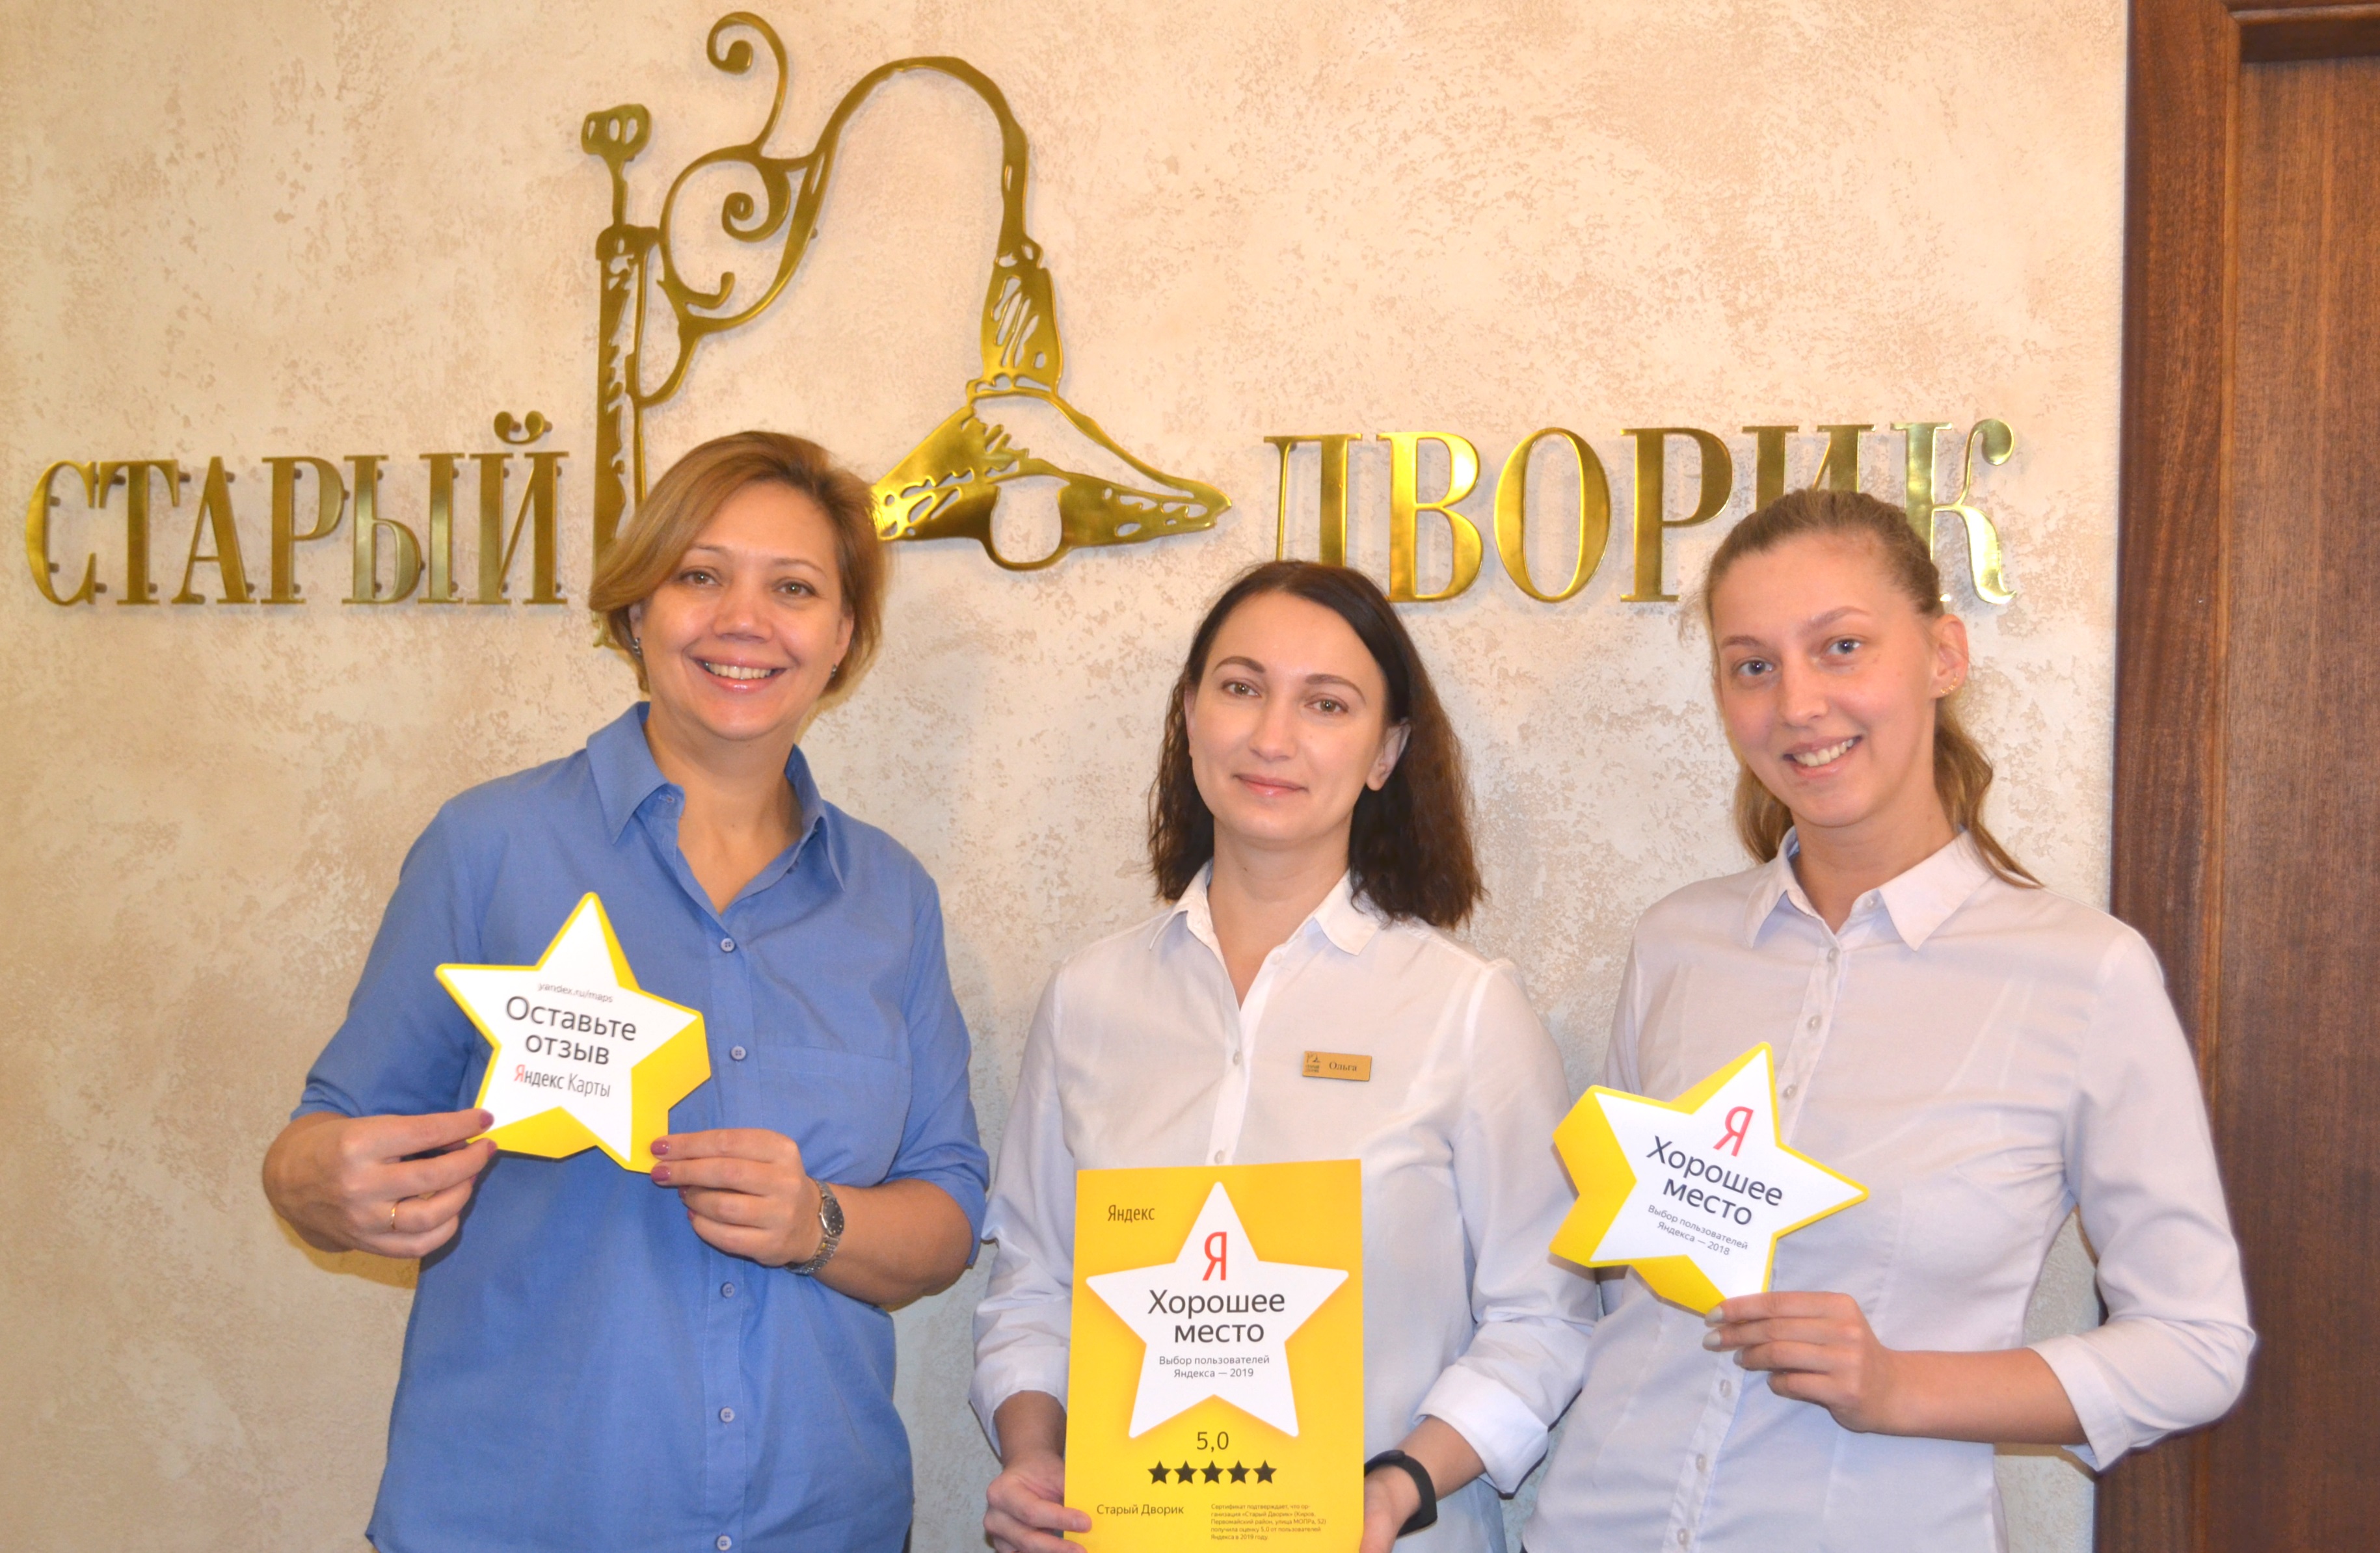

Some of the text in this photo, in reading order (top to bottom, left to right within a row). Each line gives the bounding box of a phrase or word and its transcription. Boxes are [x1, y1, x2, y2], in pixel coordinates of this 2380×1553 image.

[26, 411, 569, 605] СТАРЫЙ
[538, 983, 613, 1003] yandex.ru/maps
[506, 996, 637, 1041] Оставьте
[526, 1035, 609, 1065] отзыв
[514, 1064, 611, 1097] Яндекс Карты
[1713, 1106, 1754, 1157] Я
[1646, 1135, 1783, 1206] Хорошее
[1107, 1204, 1155, 1223] Яндекс
[1663, 1178, 1752, 1225] место
[1648, 1204, 1748, 1249] Выбор пользователей
[1657, 1221, 1695, 1242] Яндекса
[1707, 1241, 1730, 1255] 2018
[1202, 1231, 1227, 1281] Я
[1147, 1290, 1285, 1318] Хорошее
[1174, 1323, 1264, 1343] место
[1159, 1355, 1270, 1366] Выбор пользователей
[1174, 1369, 1215, 1379] Яндекса
[1230, 1368, 1254, 1377] 2019
[1196, 1431, 1229, 1452] 5,0
[1097, 1504, 1184, 1516] Старый Дворик
